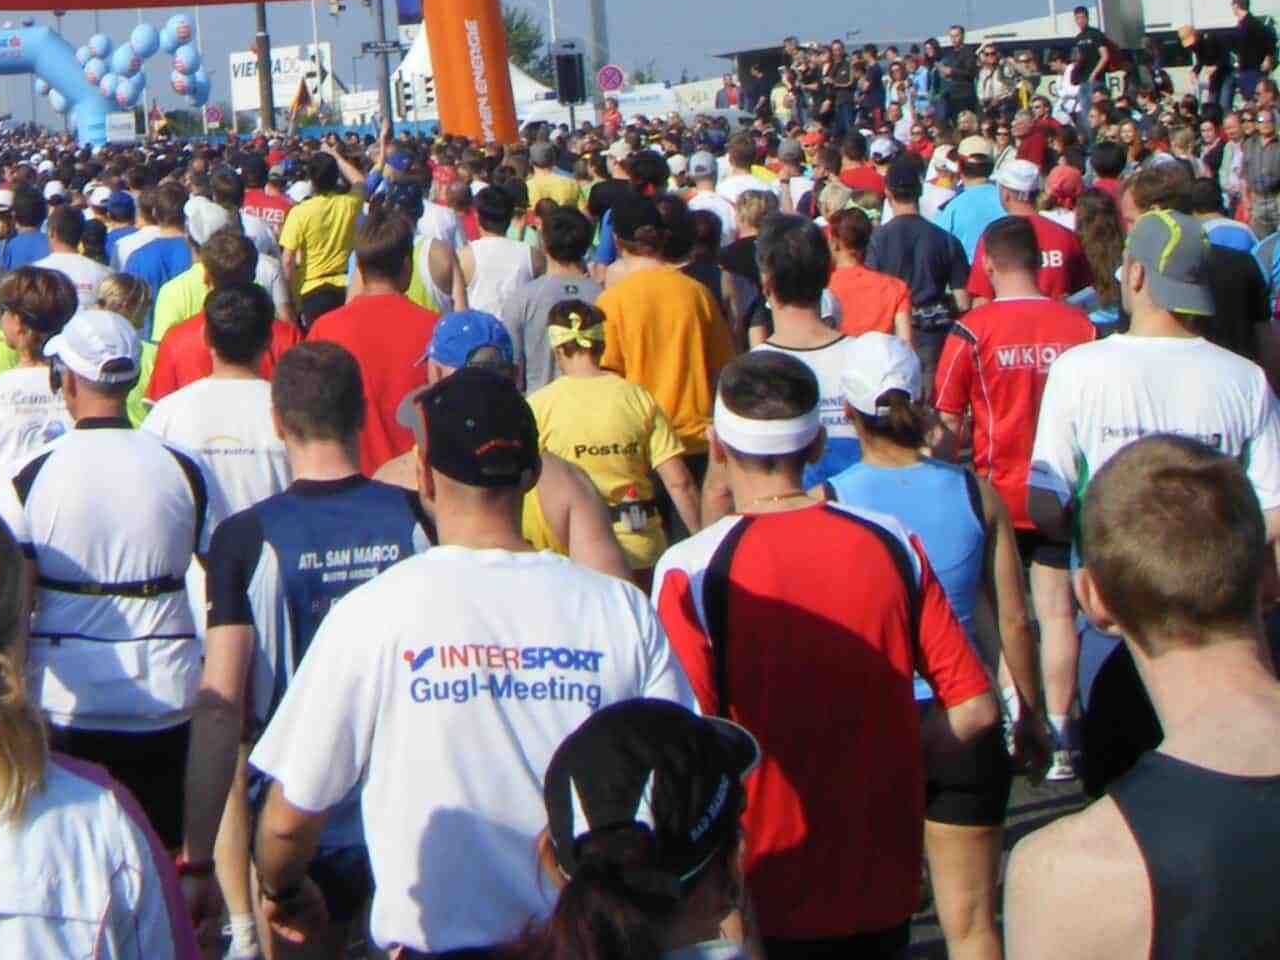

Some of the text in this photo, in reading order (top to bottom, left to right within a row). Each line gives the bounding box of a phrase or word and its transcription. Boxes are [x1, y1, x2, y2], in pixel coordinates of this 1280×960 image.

[326, 549, 351, 568] SAN
[353, 544, 400, 564] MARCO
[440, 645, 604, 672] INTERSPORT
[411, 674, 602, 707] Gugl-Meeting
